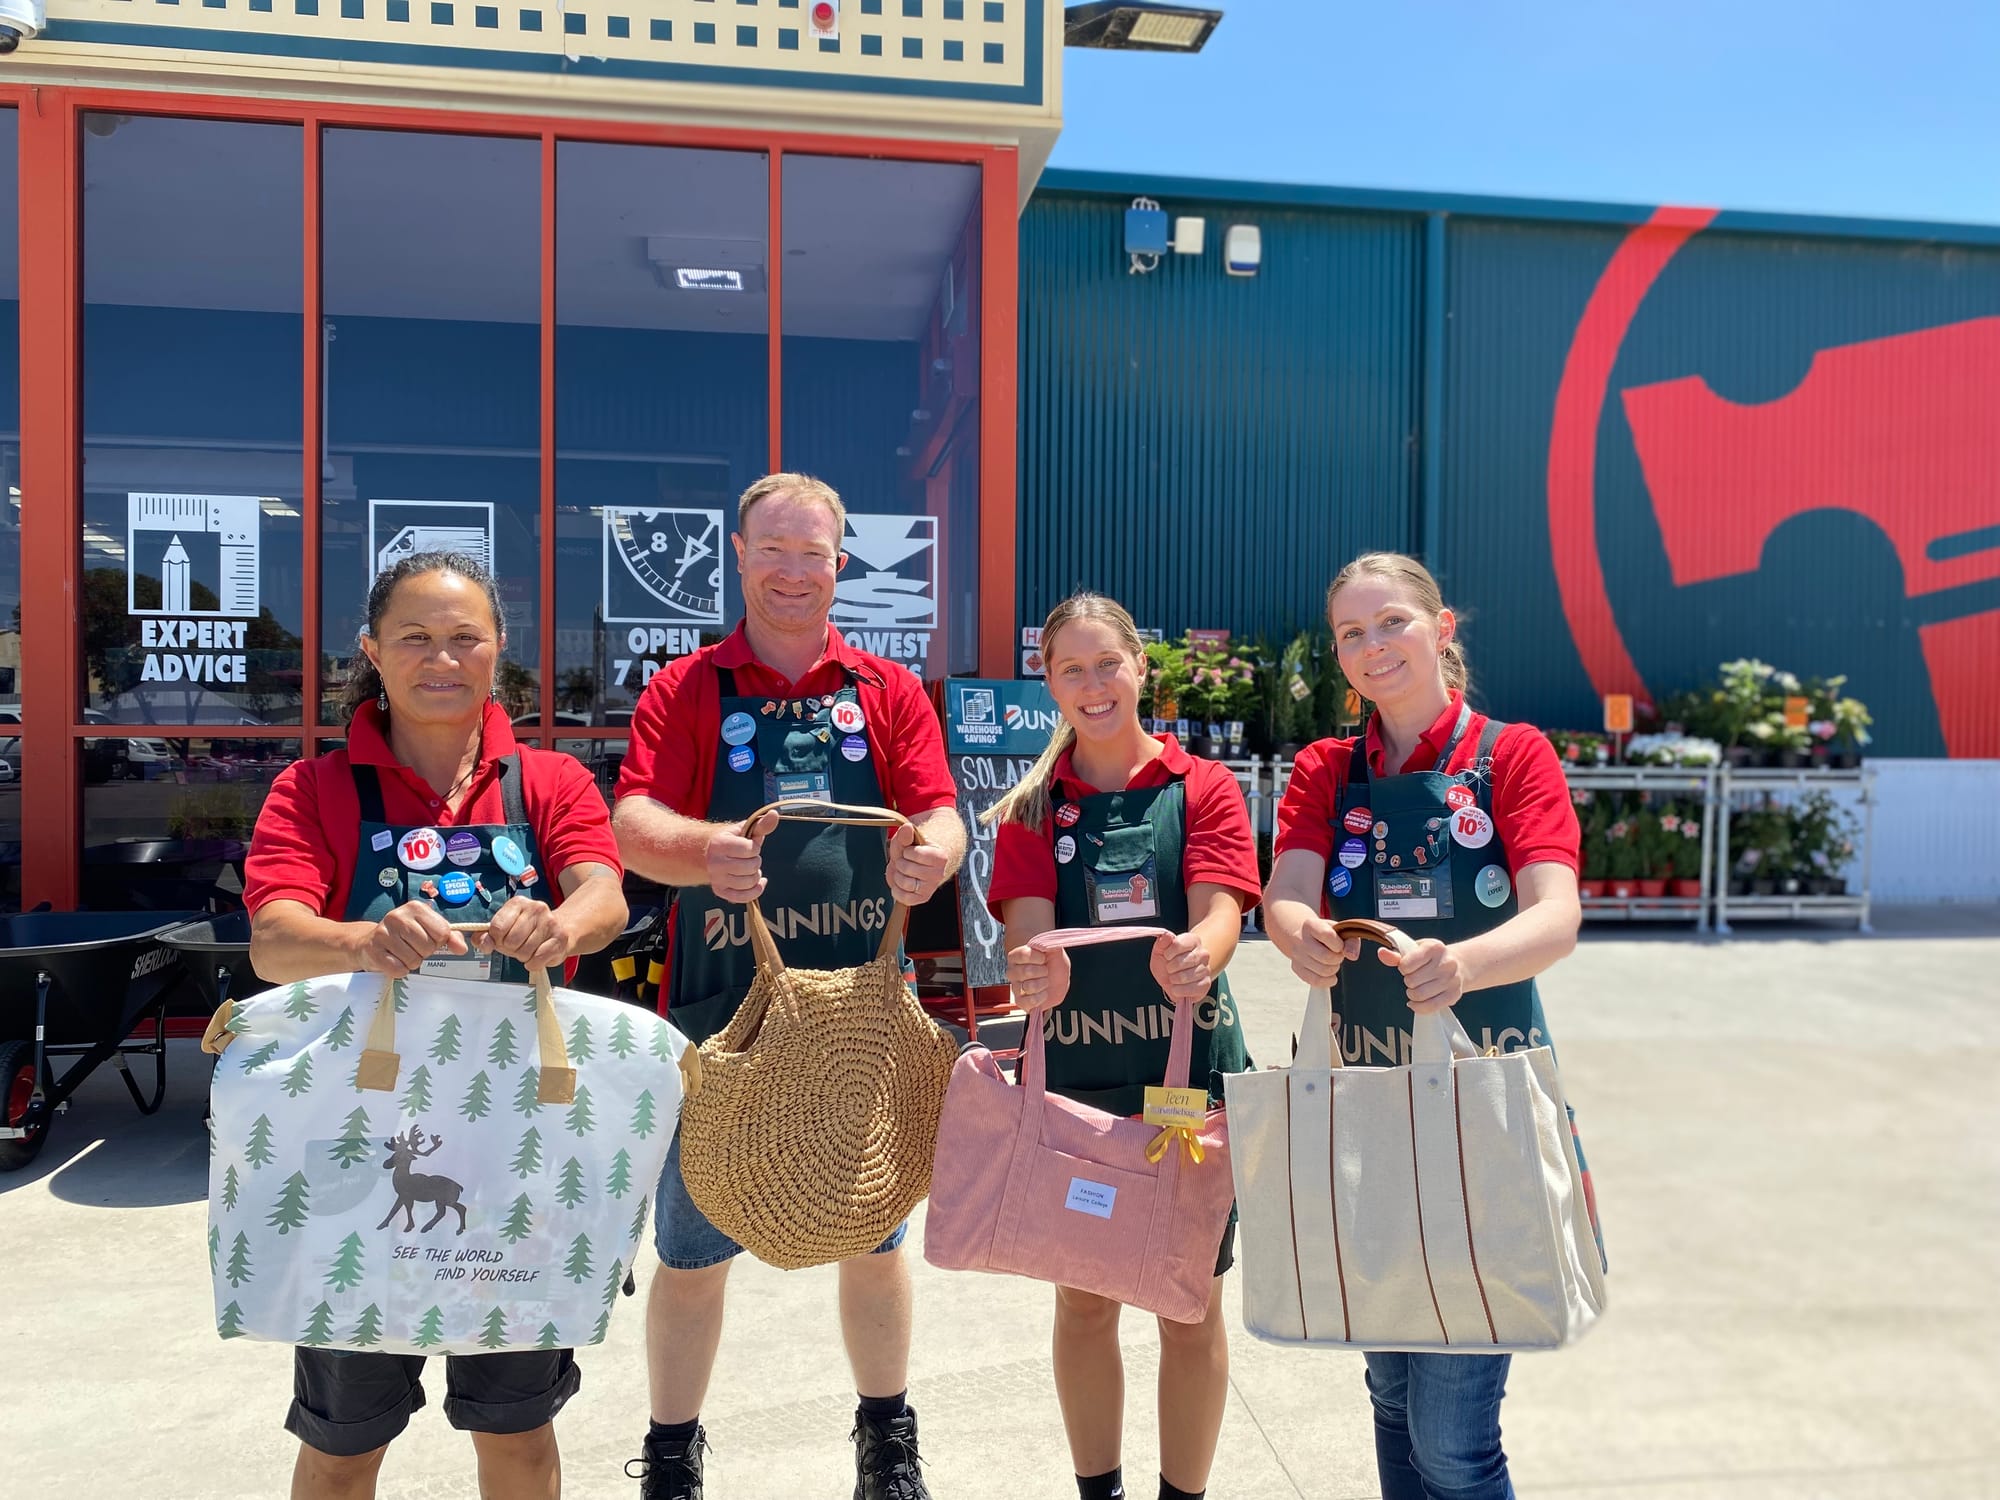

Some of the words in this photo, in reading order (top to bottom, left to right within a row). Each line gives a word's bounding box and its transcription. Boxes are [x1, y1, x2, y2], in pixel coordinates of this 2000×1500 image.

[141, 619, 248, 649] EXPERT
[628, 628, 700, 654] OPEN
[846, 632, 931, 658] OWEST
[140, 653, 247, 683] ADVICE
[613, 659, 633, 686] 7
[956, 724, 1003, 735] WAREHOUSE
[964, 734, 997, 744] SAVINGS
[1457, 815, 1487, 836] 10%
[402, 838, 442, 862] 10%
[444, 880, 469, 890] SPECIAL
[445, 887, 471, 896] ORDERS
[427, 960, 447, 968] MANU
[1165, 1090, 1190, 1106] Teen
[1080, 1188, 1105, 1199] FASHION
[391, 1245, 420, 1259] SEE
[425, 1248, 451, 1263] THE
[454, 1248, 504, 1263] WORLD
[433, 1266, 466, 1281] FIND
[470, 1266, 540, 1282] YOURSELF
